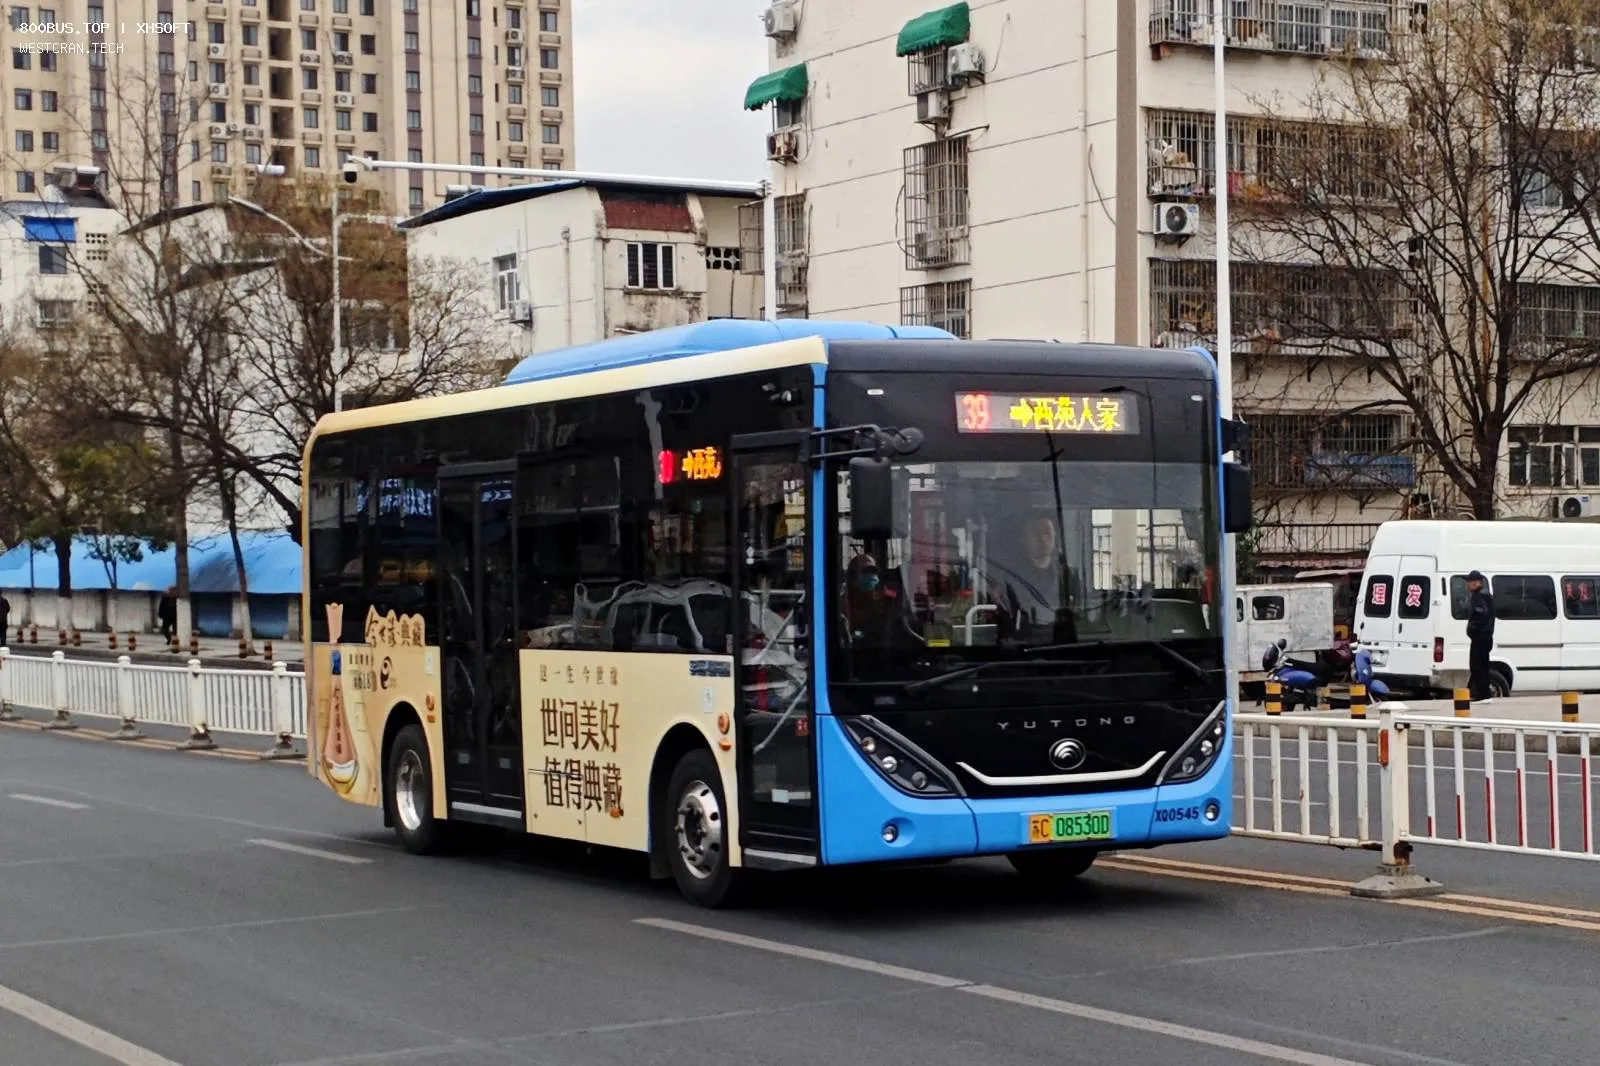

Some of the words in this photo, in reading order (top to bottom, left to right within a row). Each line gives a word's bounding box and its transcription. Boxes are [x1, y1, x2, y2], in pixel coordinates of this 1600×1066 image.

[962, 394, 989, 430] 39
[1029, 396, 1121, 431] 西苑人家
[539, 697, 621, 753] 世间美好
[997, 715, 1136, 730] YUTONG
[543, 755, 623, 813] 值得典藏
[1154, 806, 1200, 822] XQ0545
